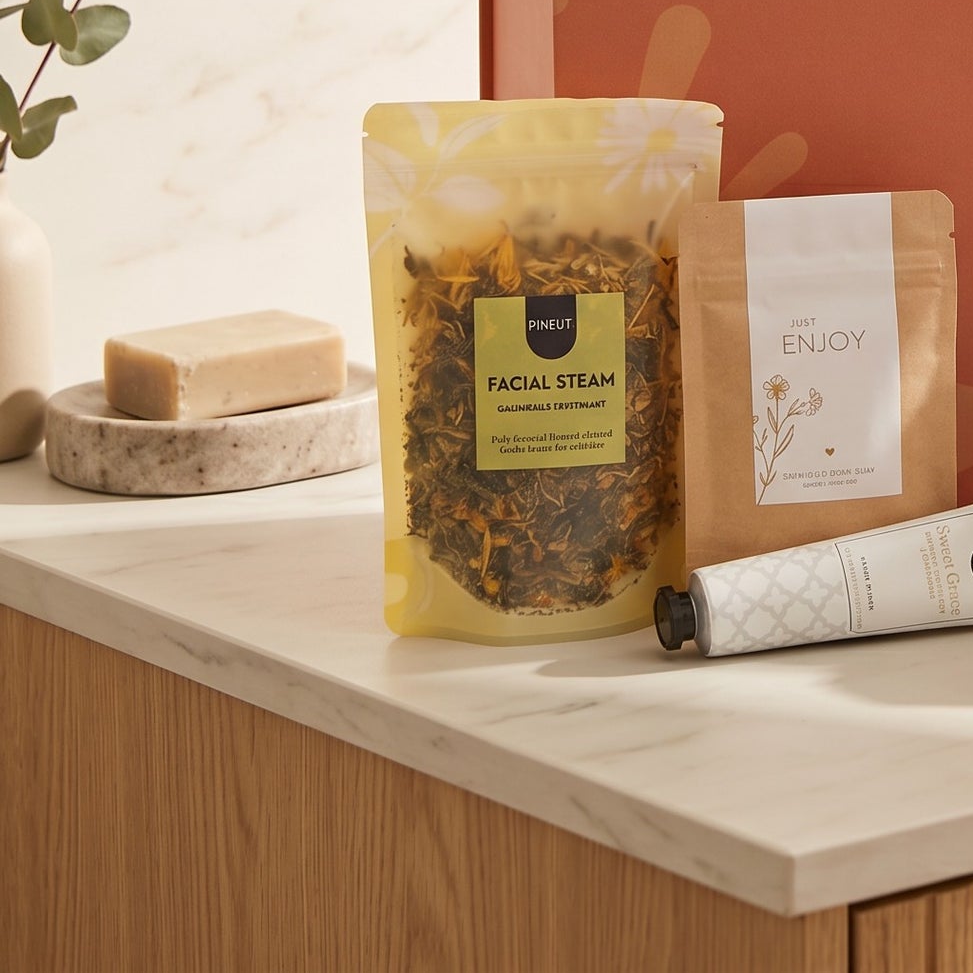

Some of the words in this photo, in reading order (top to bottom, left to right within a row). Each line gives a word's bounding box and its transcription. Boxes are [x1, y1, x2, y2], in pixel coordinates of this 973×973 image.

[528, 318, 573, 331] PINEUT
[790, 318, 816, 327] JUST
[782, 330, 866, 355] ENJOY
[487, 375, 551, 392] FACIAL
[556, 371, 615, 389] STEAM
[945, 572, 961, 616] Grace
